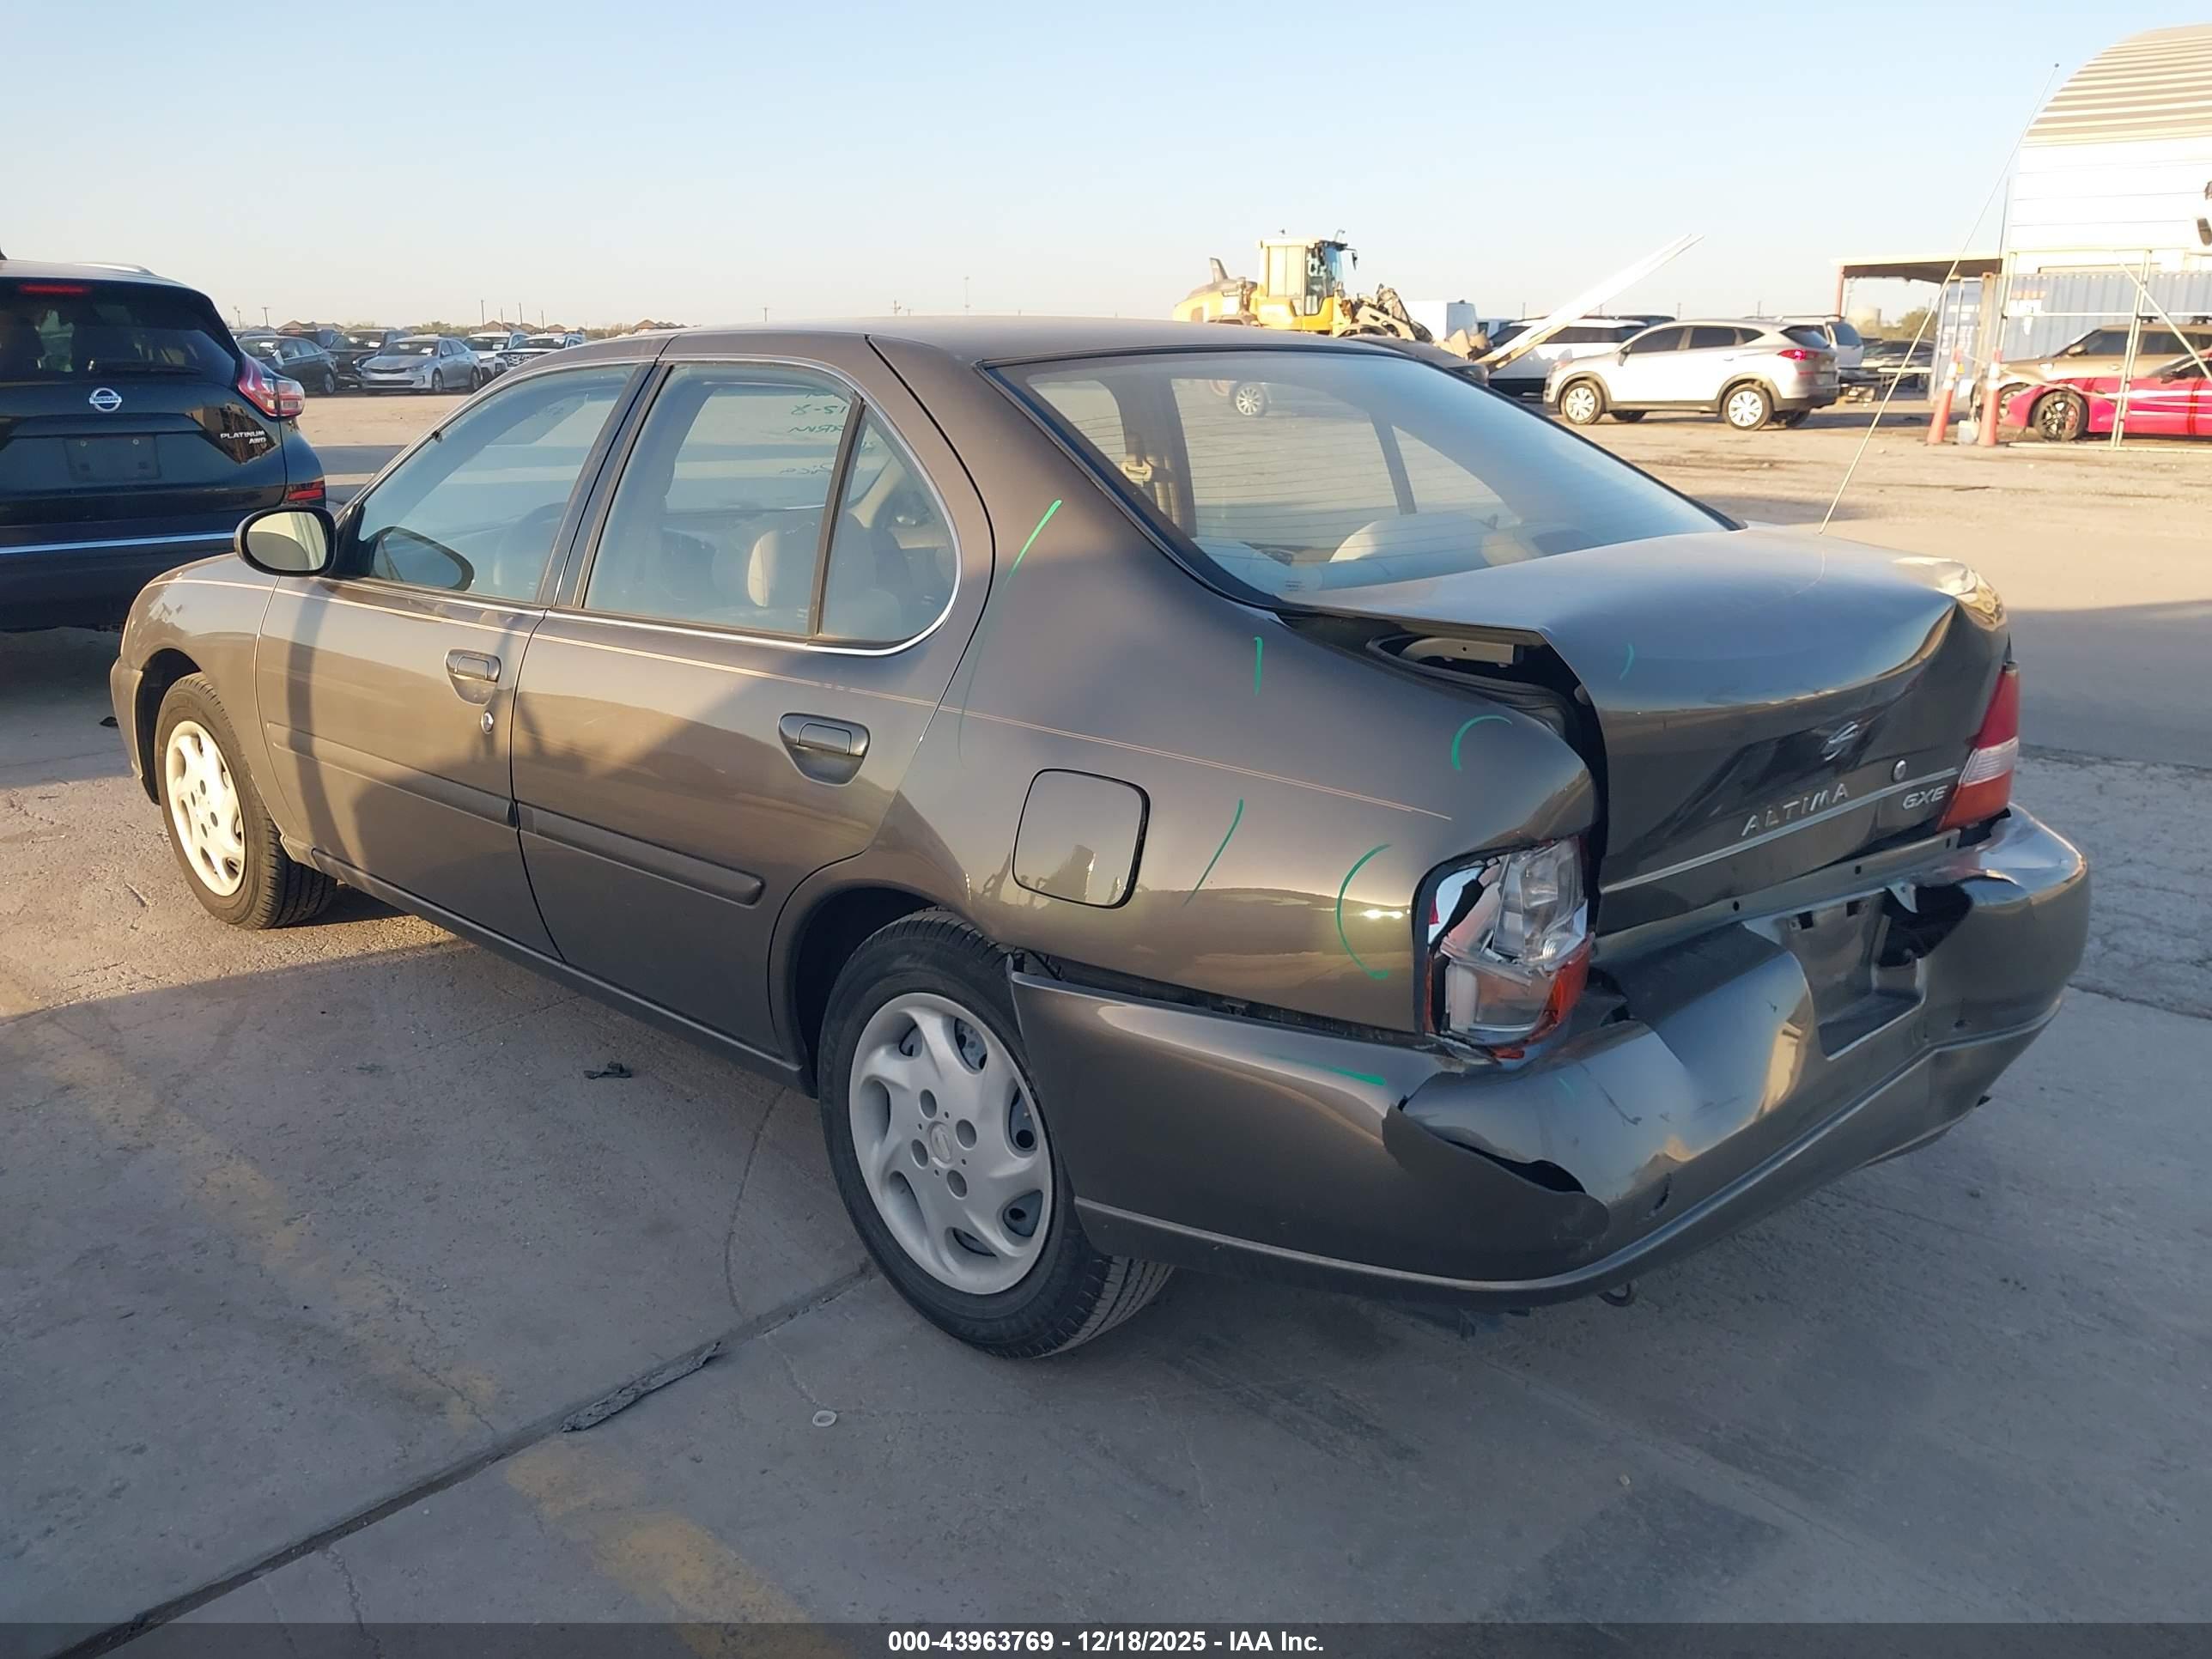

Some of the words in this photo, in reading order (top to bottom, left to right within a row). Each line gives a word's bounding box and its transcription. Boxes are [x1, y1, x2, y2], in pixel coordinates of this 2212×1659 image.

[220, 430, 264, 440] PLATINUM
[1741, 782, 1848, 836] ALTIMA
[1903, 785, 1948, 810] GXE
